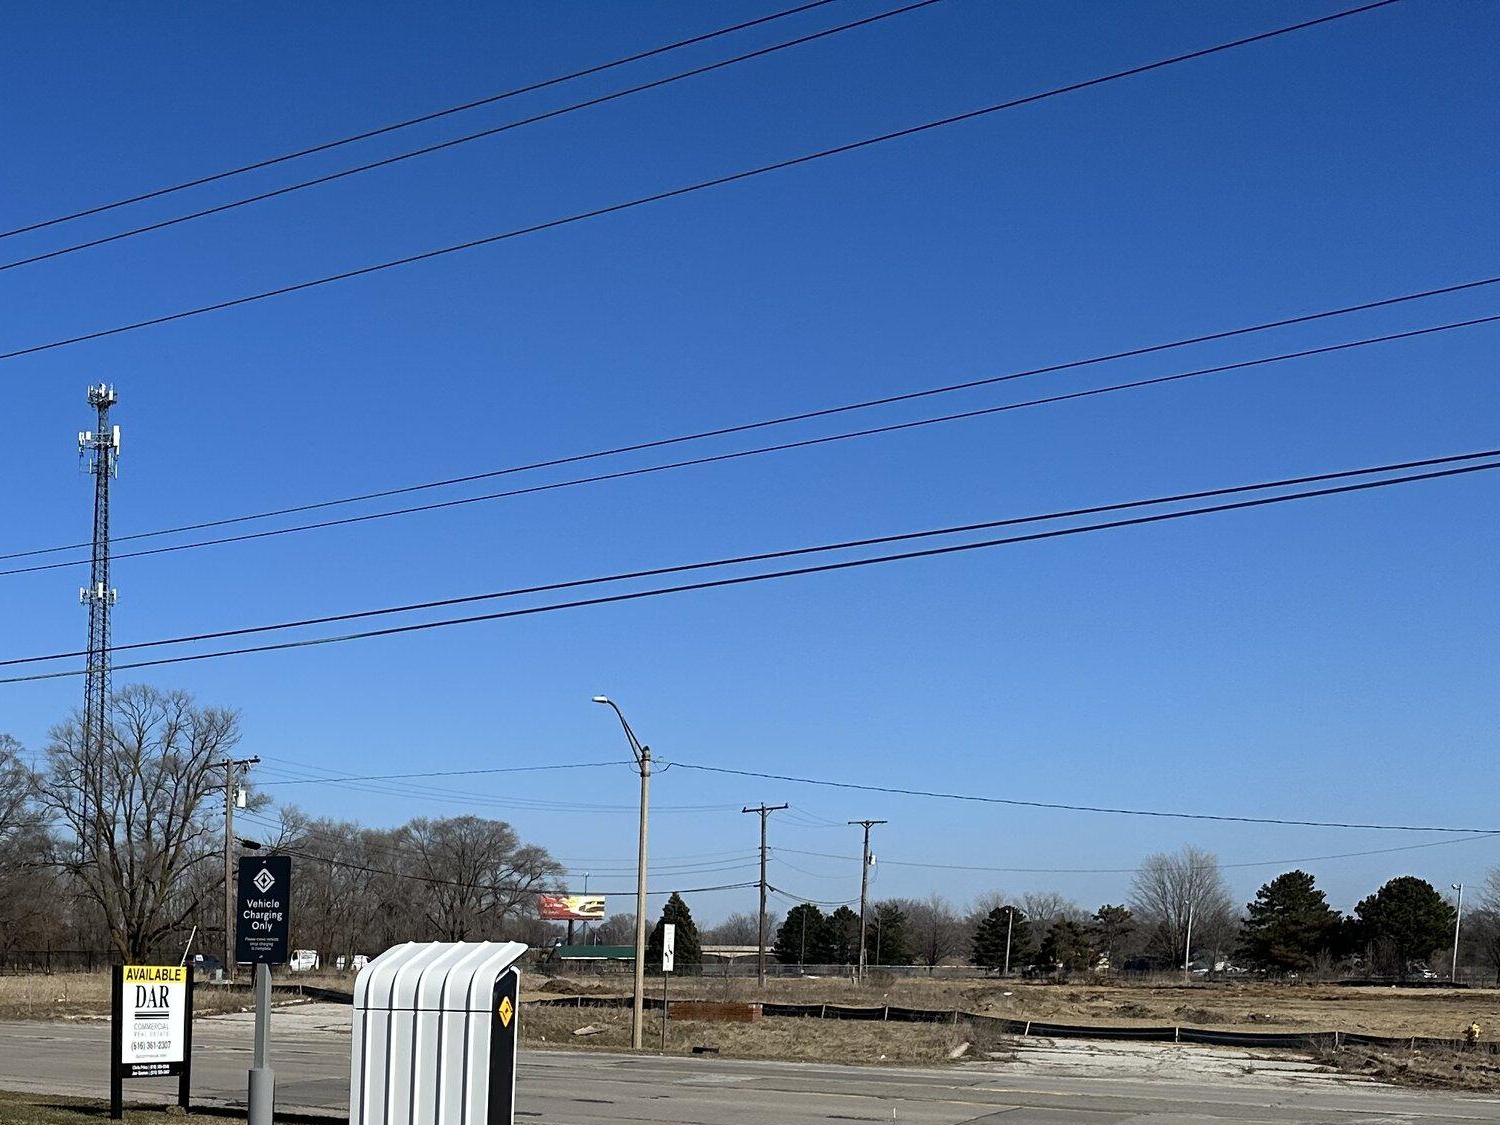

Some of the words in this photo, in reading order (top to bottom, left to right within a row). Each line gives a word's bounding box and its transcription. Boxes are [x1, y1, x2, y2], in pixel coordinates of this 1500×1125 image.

[247, 899, 280, 908] Vehicle
[243, 910, 283, 921] Charging
[252, 921, 273, 932] Only
[126, 968, 181, 981] AVAILABLE
[135, 985, 169, 1008] DAR
[133, 1022, 169, 1030] COMMERCIAL
